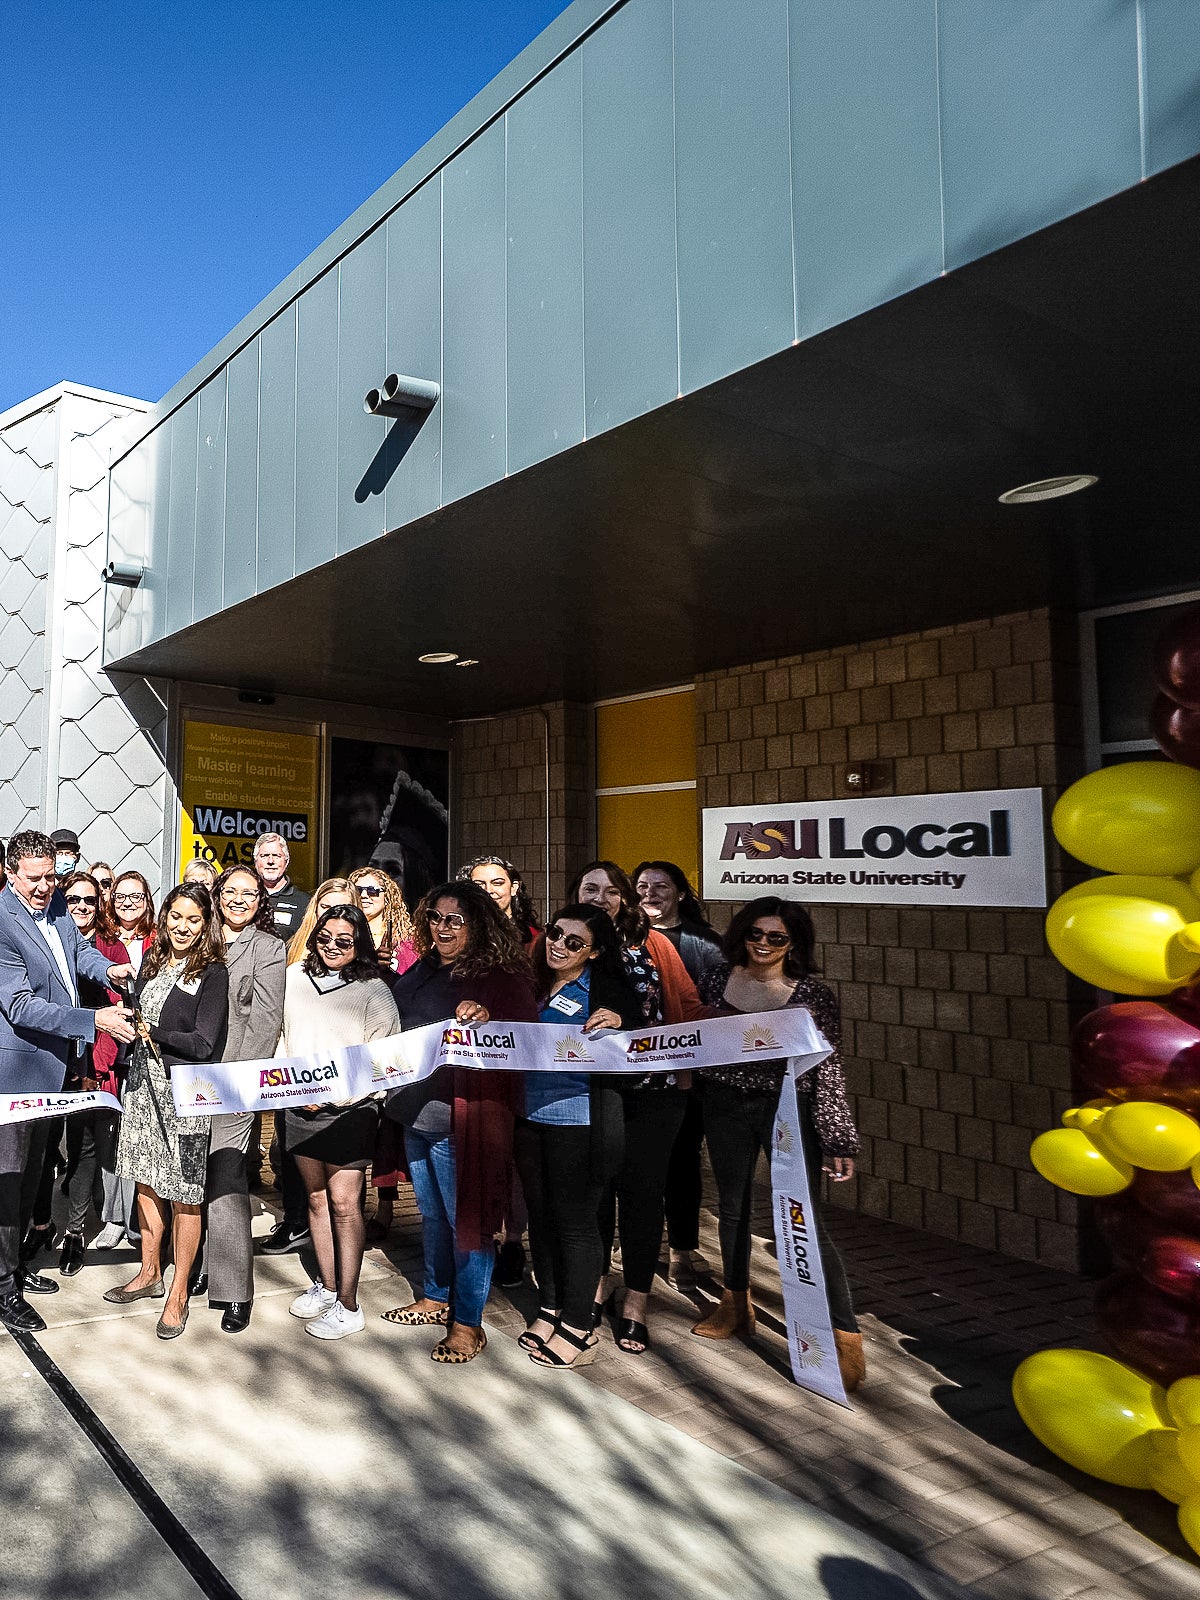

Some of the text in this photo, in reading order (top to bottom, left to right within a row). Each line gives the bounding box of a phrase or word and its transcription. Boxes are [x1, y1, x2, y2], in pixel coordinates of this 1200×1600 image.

[198, 757, 296, 782] Master learning
[205, 790, 314, 809] Enable student success
[195, 808, 306, 839] Welcome
[719, 810, 1012, 860] ASU Local
[193, 841, 253, 866] to AS
[720, 870, 966, 890] Arizona State University
[441, 1028, 516, 1049] ASU Local
[626, 1029, 702, 1053] ASU Local
[481, 1051, 509, 1061] University
[626, 1056, 649, 1064] Arizona
[665, 1052, 695, 1061] University
[259, 1060, 339, 1088] ASU Local
[260, 1085, 332, 1100] Arizona State University
[779, 1195, 787, 1220] Arizona
[784, 1237, 793, 1270] University
[788, 1196, 817, 1287] ASU Local
